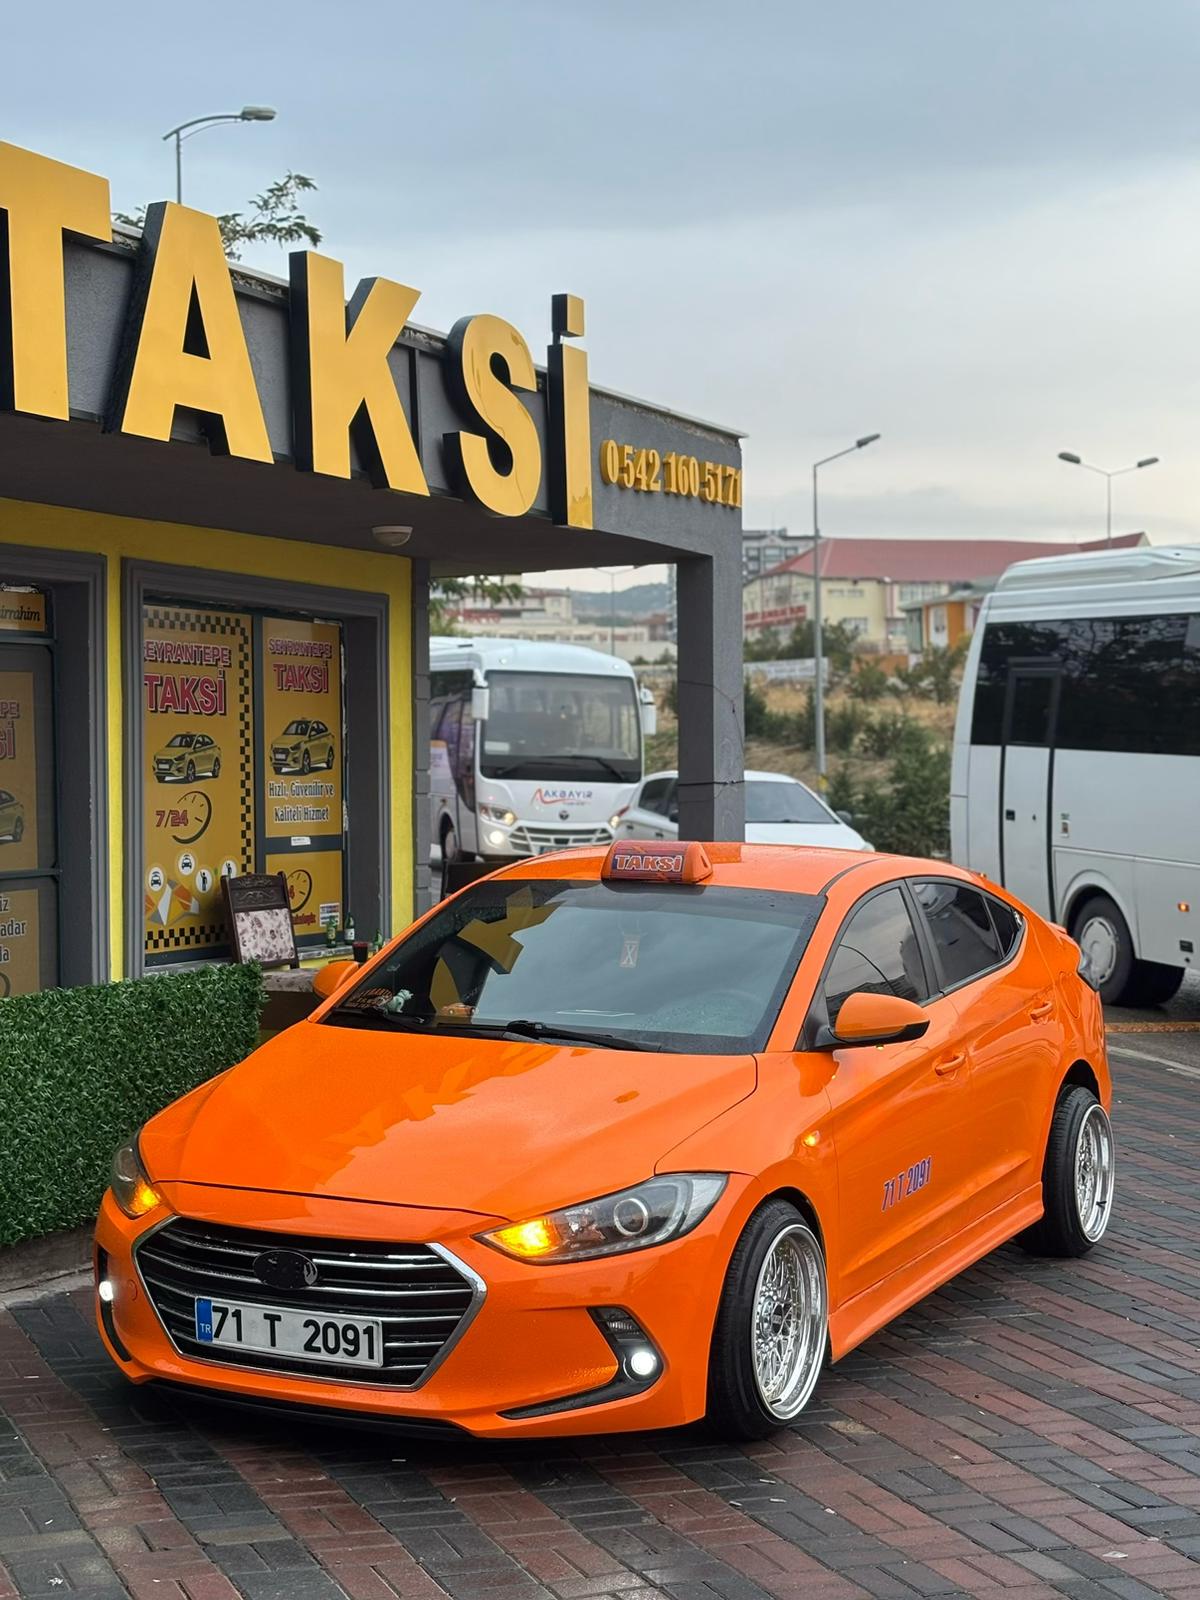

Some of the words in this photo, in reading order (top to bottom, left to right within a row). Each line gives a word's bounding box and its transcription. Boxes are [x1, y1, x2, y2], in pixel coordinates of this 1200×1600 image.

[0, 140, 592, 530] TAKSİ
[664, 452, 700, 497] 160
[144, 640, 232, 668] EYRANTEPE
[273, 659, 329, 693] TAKSİ
[144, 667, 227, 716] TAKSİ
[155, 809, 189, 828] 7/24
[615, 854, 683, 873] TAKSİ
[882, 1178, 895, 1213] 71
[898, 1171, 905, 1201] T
[905, 1154, 932, 1197] 2091
[200, 1322, 212, 1334] TR
[212, 1305, 243, 1343] 71
[263, 1312, 282, 1348] T
[303, 1318, 375, 1361] 2091
